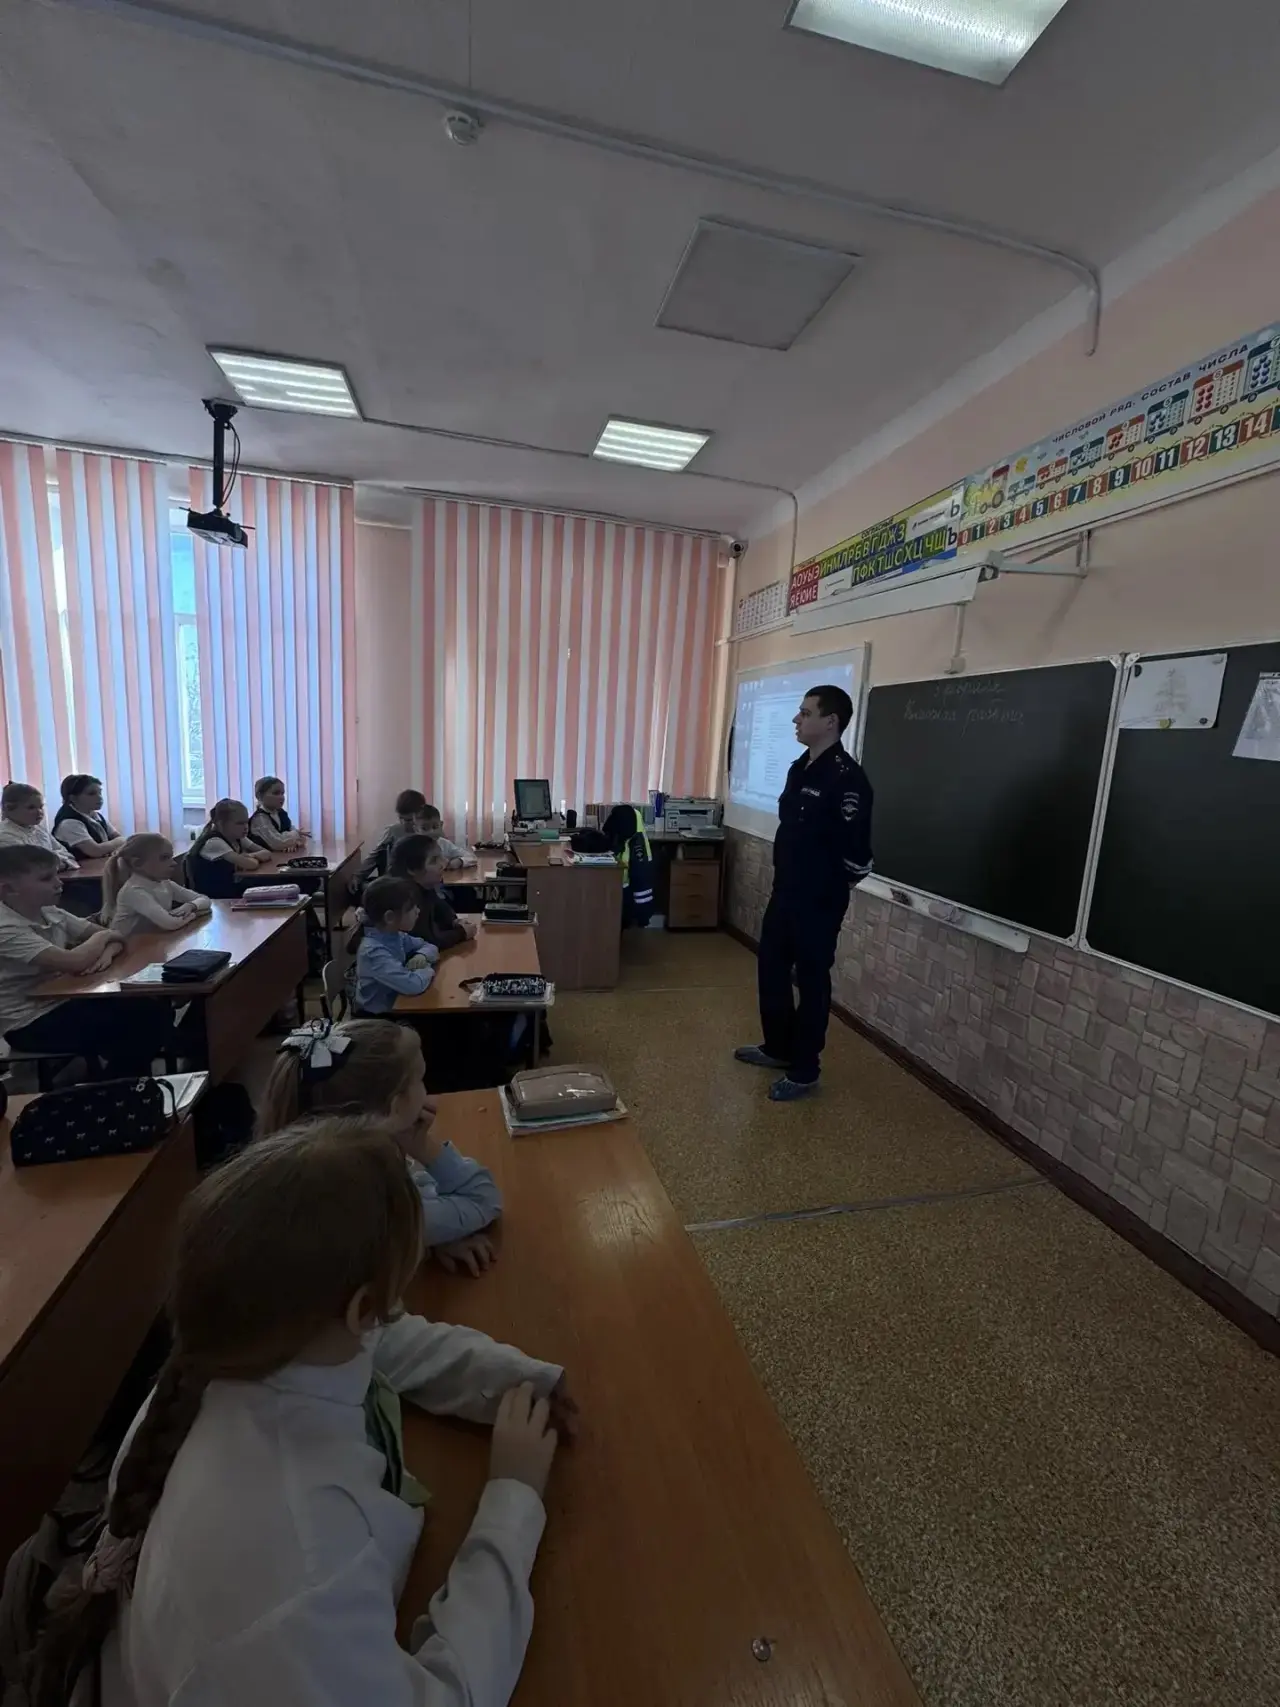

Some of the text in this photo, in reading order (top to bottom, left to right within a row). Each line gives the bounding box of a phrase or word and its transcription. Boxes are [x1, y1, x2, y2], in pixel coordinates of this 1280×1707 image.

[1141, 371, 1192, 401] СОСТАВ
[1199, 344, 1249, 371] ЧИСЛА
[961, 530, 969, 544] 0
[988, 519, 996, 532] 2
[1003, 513, 1010, 528] 3
[1018, 508, 1027, 523] 4
[1035, 501, 1044, 516] 5
[1053, 493, 1062, 509] 6
[1073, 485, 1082, 502] 7
[1092, 477, 1102, 494] 8
[1113, 468, 1125, 486] 9
[1134, 457, 1151, 478] 10
[1158, 447, 1175, 470] 11
[1186, 437, 1206, 460] 12
[1214, 425, 1237, 450] 13
[1243, 412, 1268, 439] 14
